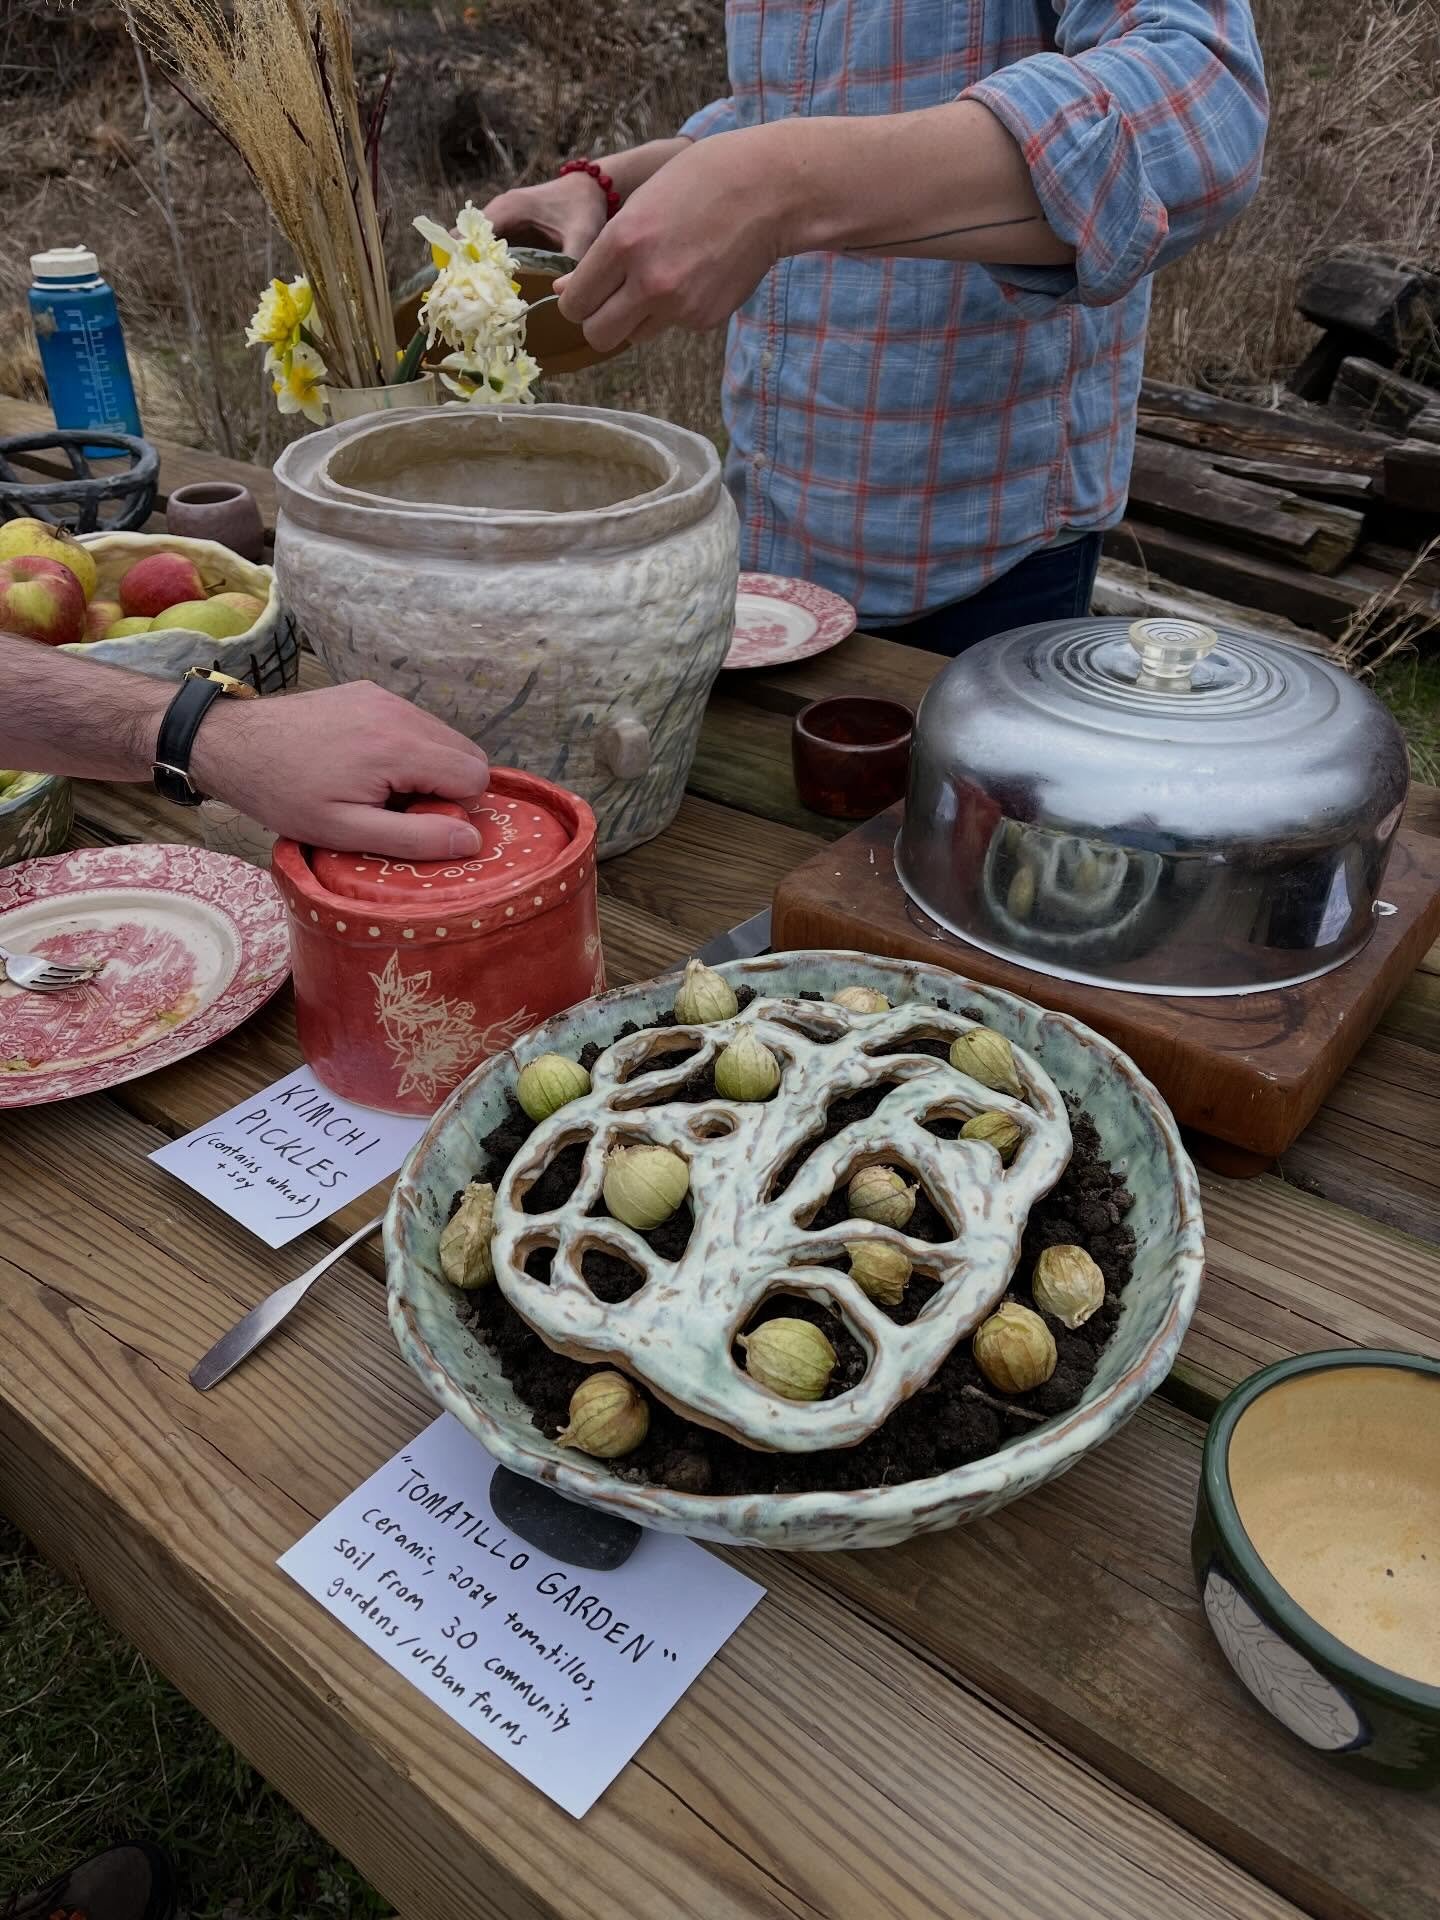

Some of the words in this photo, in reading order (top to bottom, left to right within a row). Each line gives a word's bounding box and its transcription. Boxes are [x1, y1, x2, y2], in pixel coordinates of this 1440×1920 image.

[235, 1108, 348, 1188] PICKLES
[270, 1084, 381, 1156] KIMCHI
[187, 1131, 263, 1174] (contains
[266, 1176, 321, 1220] wheat)
[227, 1170, 255, 1191] soy
[333, 1537, 376, 1572] soil
[377, 1569, 425, 1612] from
[440, 1615, 478, 1650] 30
[484, 1656, 571, 1733] community
[361, 1507, 437, 1576] ceramic,
[447, 1565, 498, 1610] 2024
[504, 1611, 596, 1702] tomatillos,
[468, 1690, 528, 1747] farms
